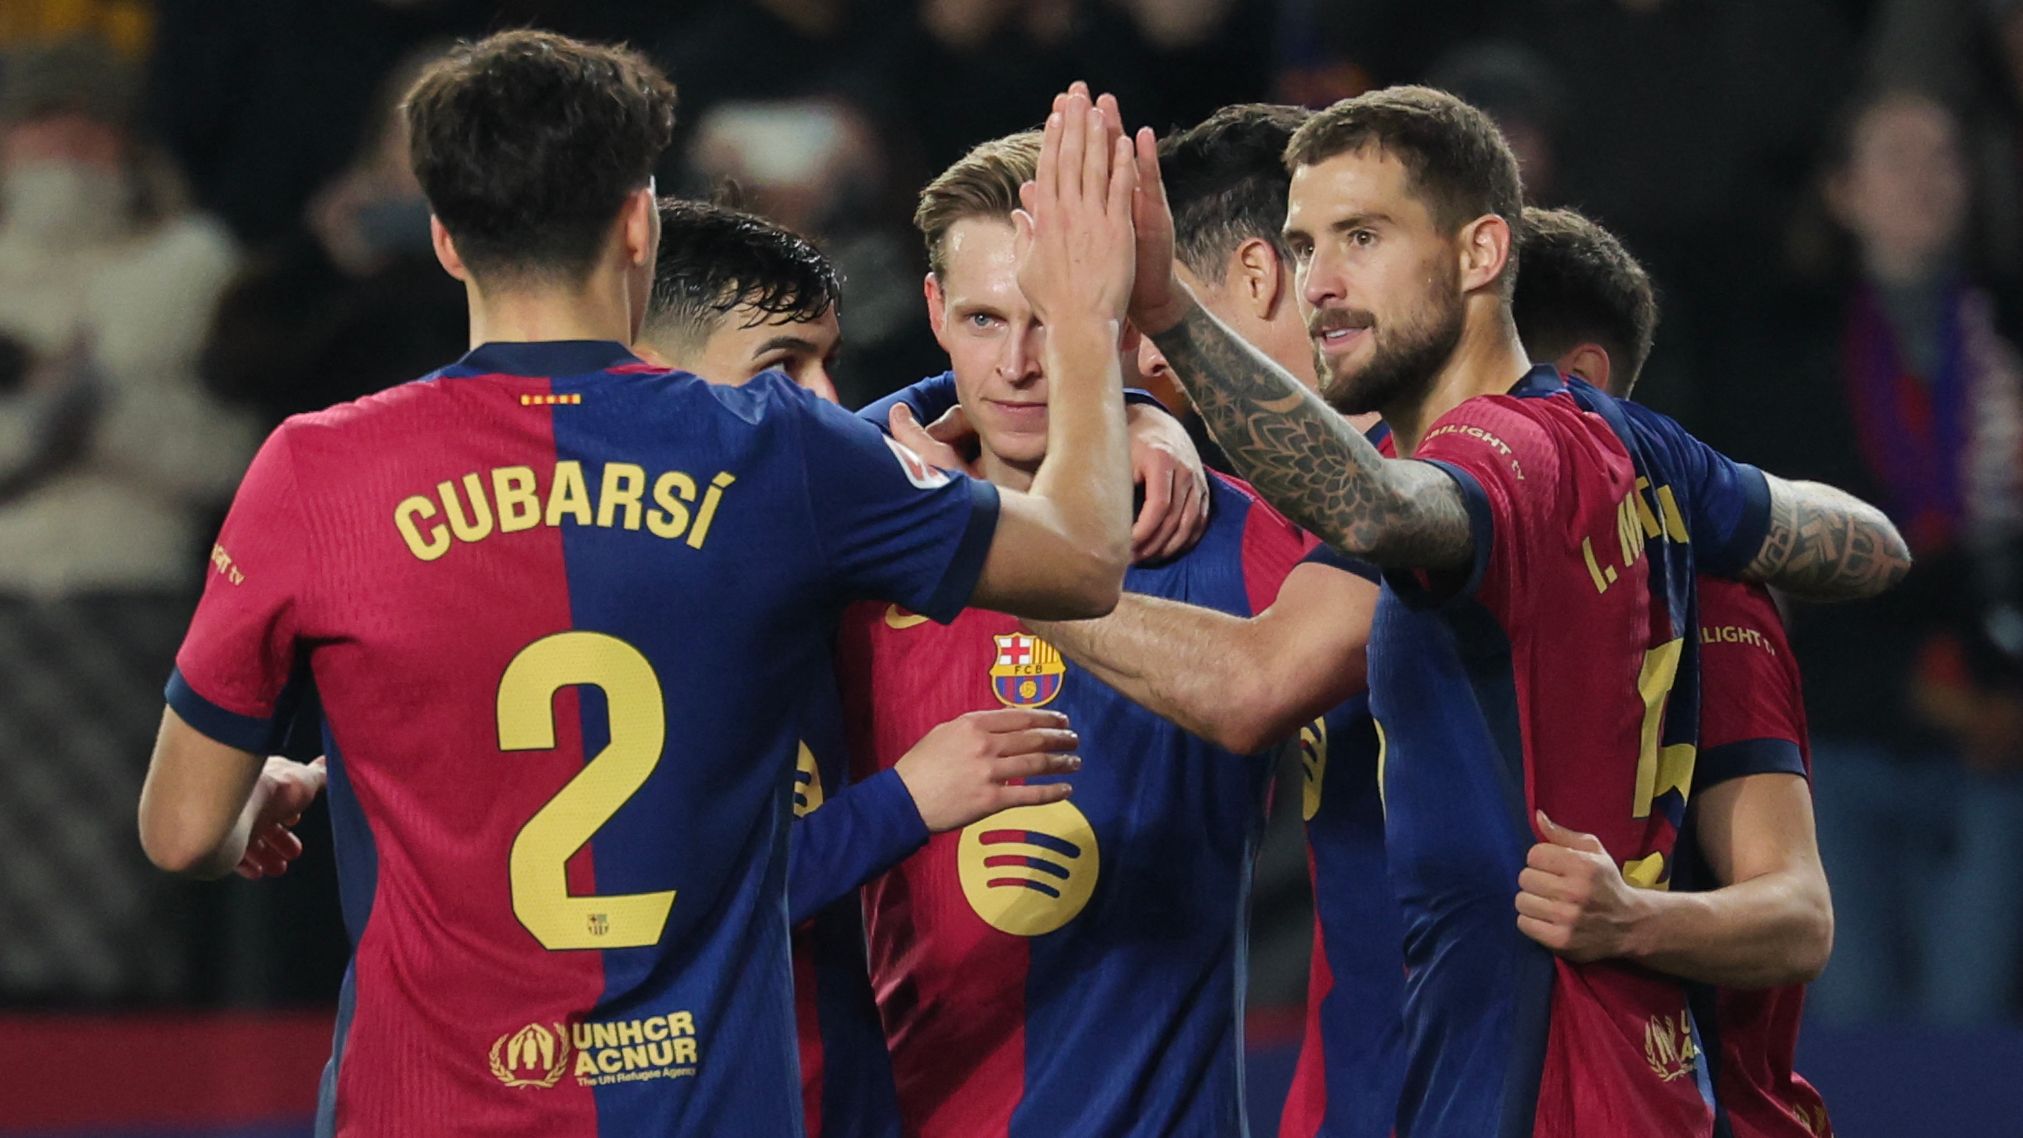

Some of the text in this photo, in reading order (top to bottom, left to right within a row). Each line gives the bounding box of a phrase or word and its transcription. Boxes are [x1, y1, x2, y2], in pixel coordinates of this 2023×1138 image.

[394, 460, 736, 562] CUBARSÍ
[1582, 535, 1618, 595] I.
[1699, 625, 1761, 648] LIGHT
[496, 630, 678, 950] 2
[572, 1010, 695, 1050] UNHCR
[574, 1037, 697, 1077] ACNUR
[577, 1066, 696, 1087] The UN Refugee Agency
